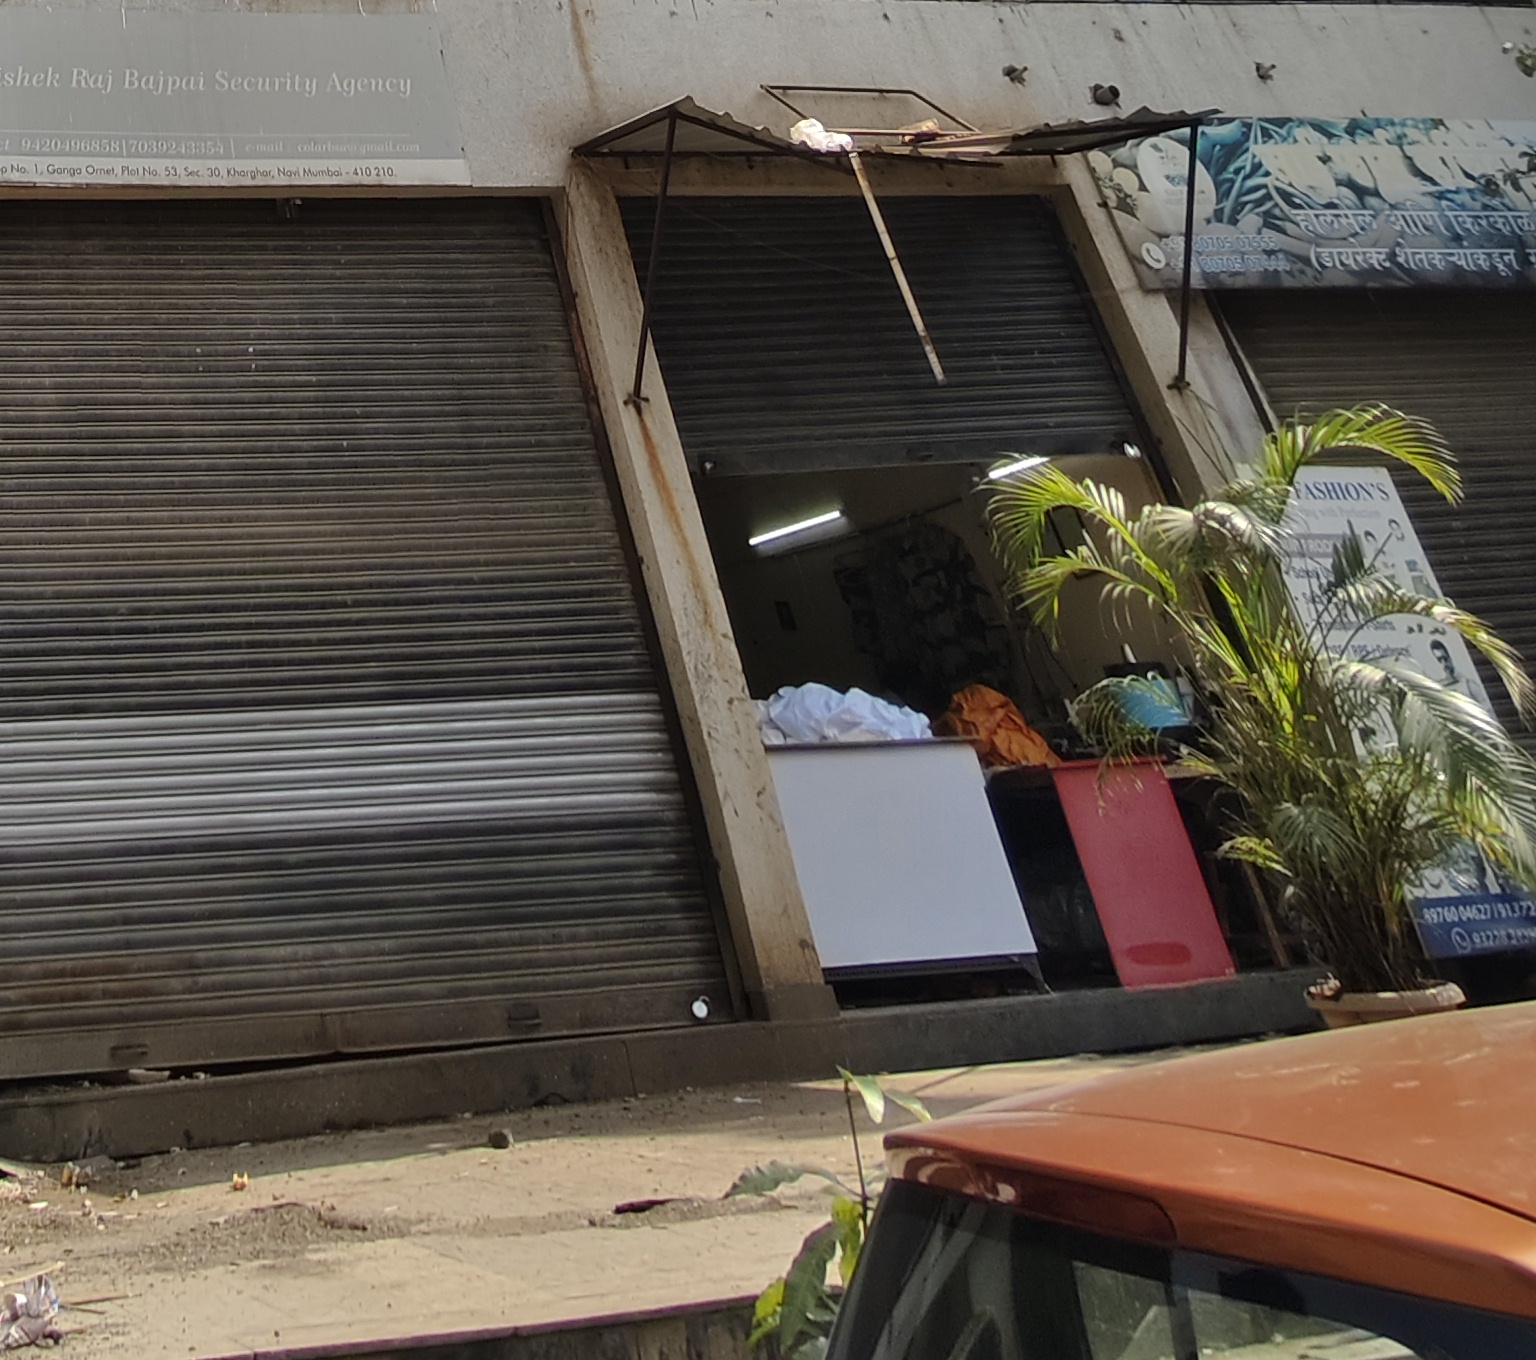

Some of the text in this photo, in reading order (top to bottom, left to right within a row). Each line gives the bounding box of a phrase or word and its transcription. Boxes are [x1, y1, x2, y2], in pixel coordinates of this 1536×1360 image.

[70, 66, 114, 94] Raj
[122, 68, 205, 96] Bajpai
[214, 67, 318, 98] Security
[325, 71, 412, 99] Agency
[10, 164, 29, 174] No.
[33, 164, 43, 176] 1,
[46, 164, 83, 177] Ganga
[85, 164, 118, 177] Ornet,
[120, 165, 140, 176] Plot
[142, 166, 162, 177] No.
[164, 166, 182, 179] 53,
[183, 167, 205, 178] Sec.
[206, 167, 224, 179] 30,
[226, 166, 276, 181] Kharghar,
[277, 166, 300, 177] Navi
[302, 166, 344, 177] Mumbai
[352, 166, 372, 177] 410
[1440, 199, 1536, 236] किरकोळ
